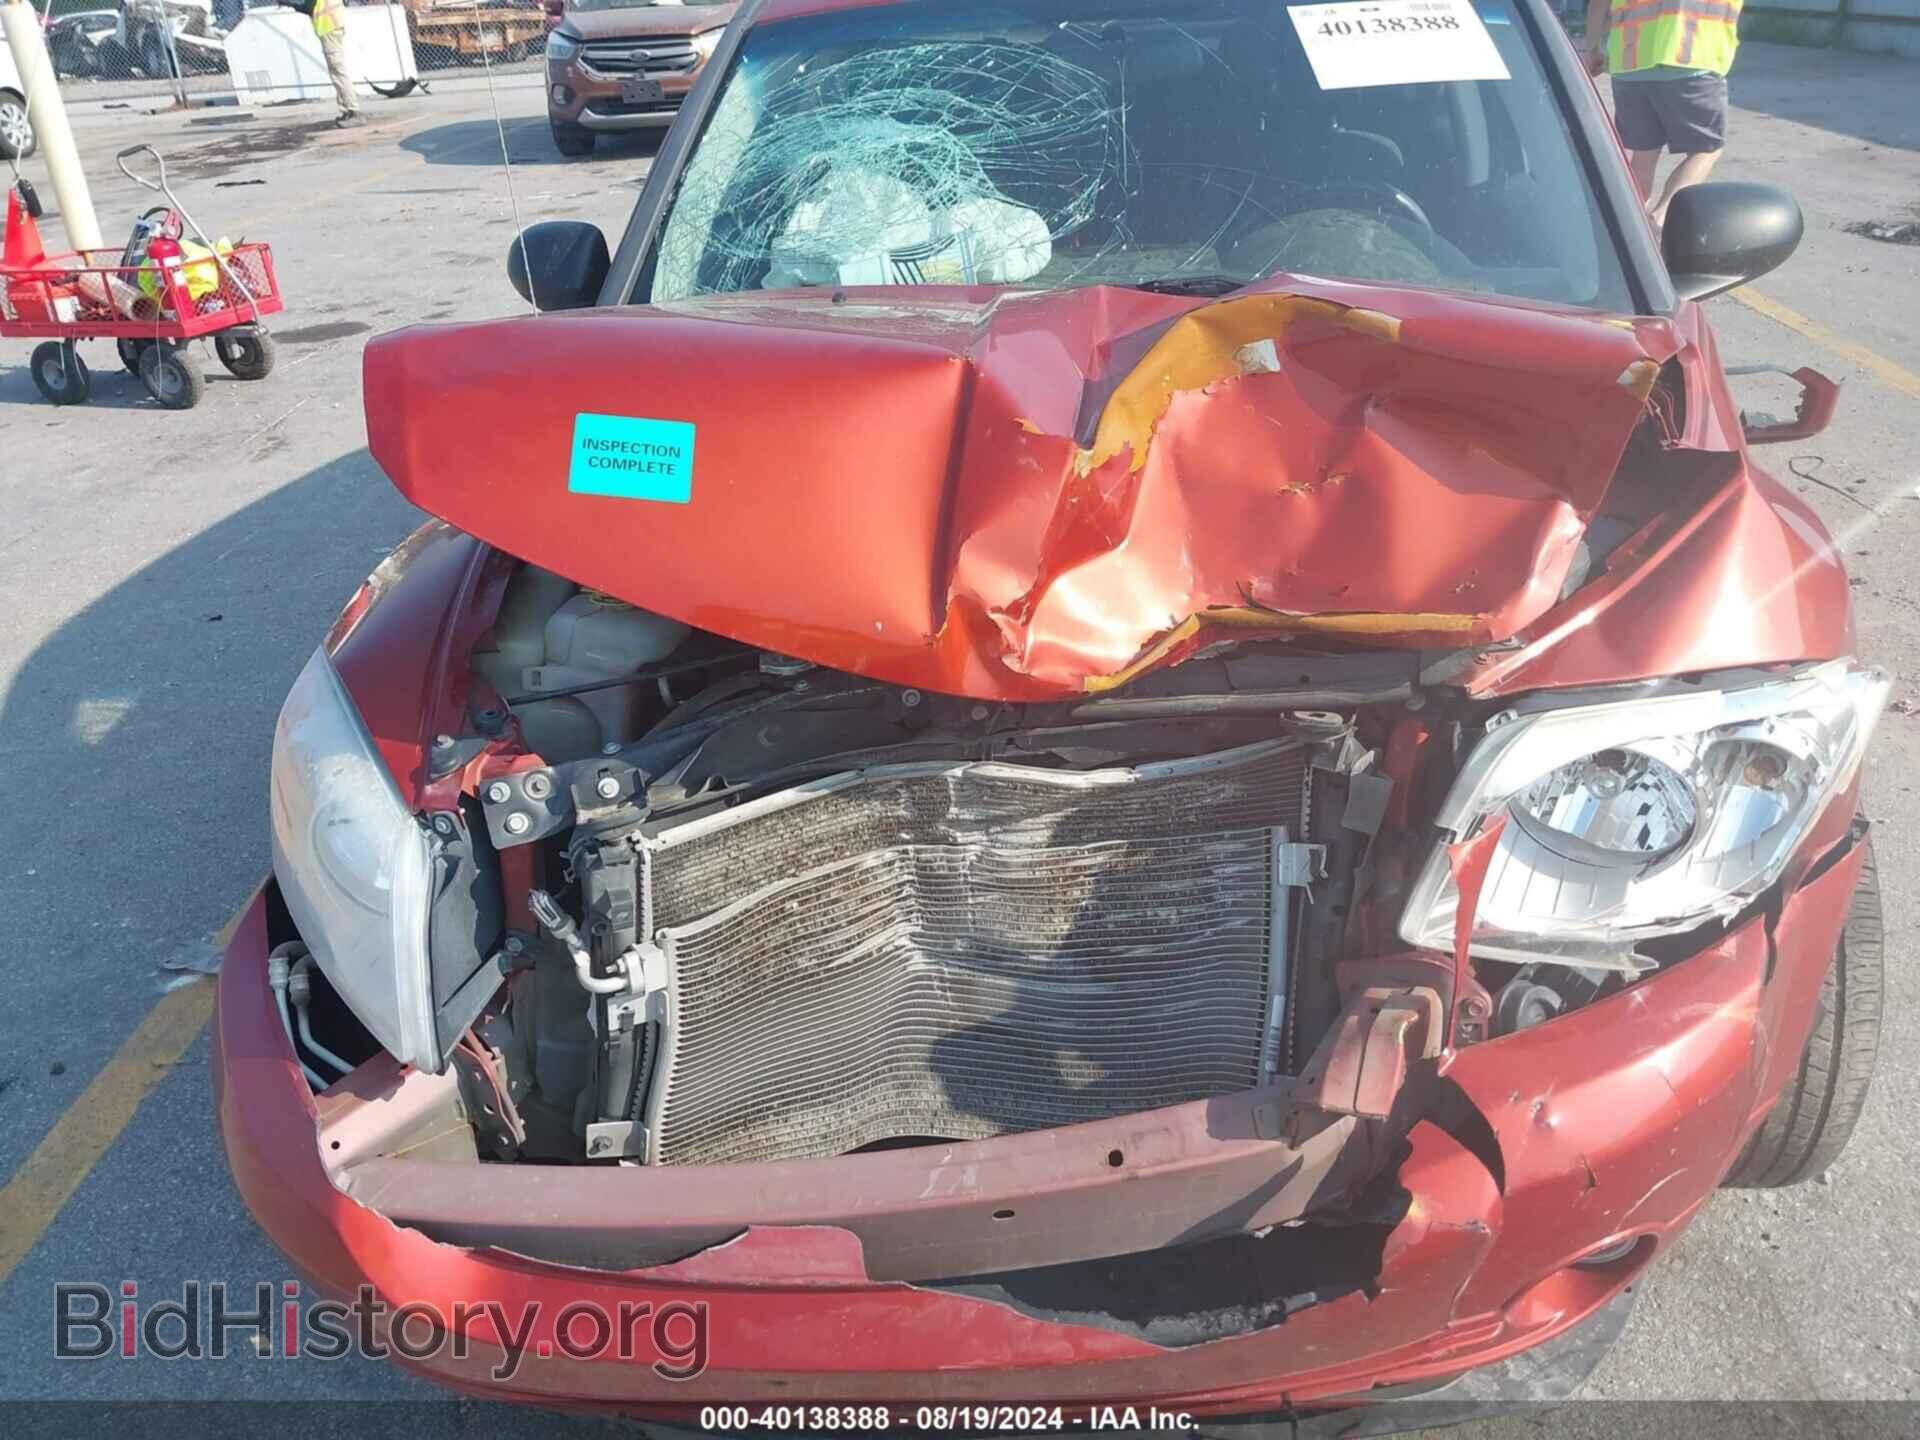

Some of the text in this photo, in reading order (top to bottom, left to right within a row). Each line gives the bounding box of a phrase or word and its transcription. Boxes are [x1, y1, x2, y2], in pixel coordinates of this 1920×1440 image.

[1317, 15, 1460, 37] 40138388
[582, 438, 681, 459] INSPECTION
[588, 455, 677, 476] COMPLETE
